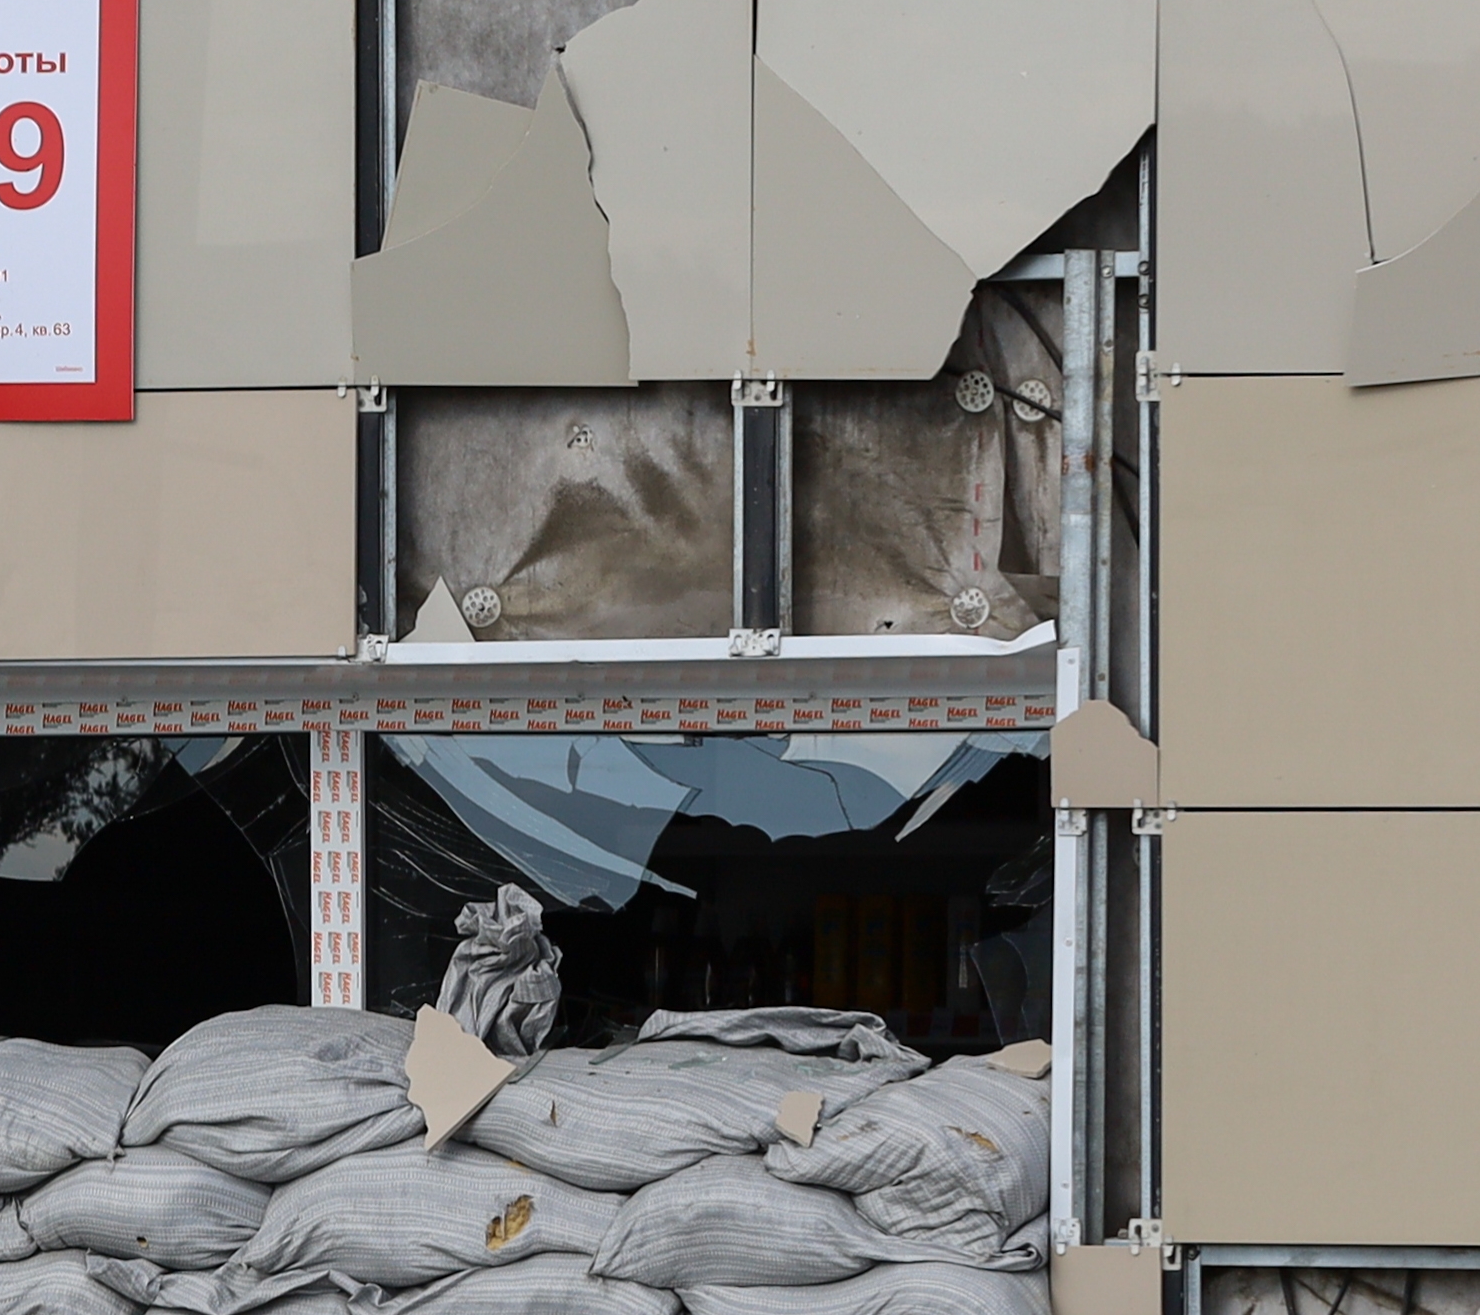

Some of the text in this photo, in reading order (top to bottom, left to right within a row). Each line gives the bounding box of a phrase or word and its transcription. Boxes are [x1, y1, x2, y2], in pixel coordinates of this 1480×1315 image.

[6, 704, 36, 714] HAGEL
[79, 704, 108, 713] HAGEL
[154, 703, 182, 712] HAGEL
[228, 701, 257, 711] HAGEL
[302, 700, 331, 710] HAGEL
[376, 700, 406, 709] HAGEL
[451, 699, 481, 709] HAGEL
[527, 699, 557, 710] HAGEL
[678, 699, 709, 709] HAGEL
[754, 699, 785, 709] HAGEL
[831, 699, 862, 708] HAGEL
[908, 697, 940, 707] HAGEL
[986, 697, 1016, 706] HAGEL
[43, 714, 72, 724] HAGEL
[117, 713, 146, 723] HAGEL
[191, 712, 220, 722] HAGEL
[265, 711, 294, 721] HAGEL
[339, 710, 369, 720] HAGEL
[414, 710, 444, 720] HAGEL
[490, 710, 520, 720] HAGEL
[565, 710, 595, 720] HAGEL
[641, 709, 671, 720] HAGEL
[717, 709, 747, 720] HAGEL
[793, 709, 824, 720] HAGEL
[870, 708, 901, 719] HAGEL
[947, 707, 978, 717] HAGEL
[1024, 706, 1055, 716] HAGEL
